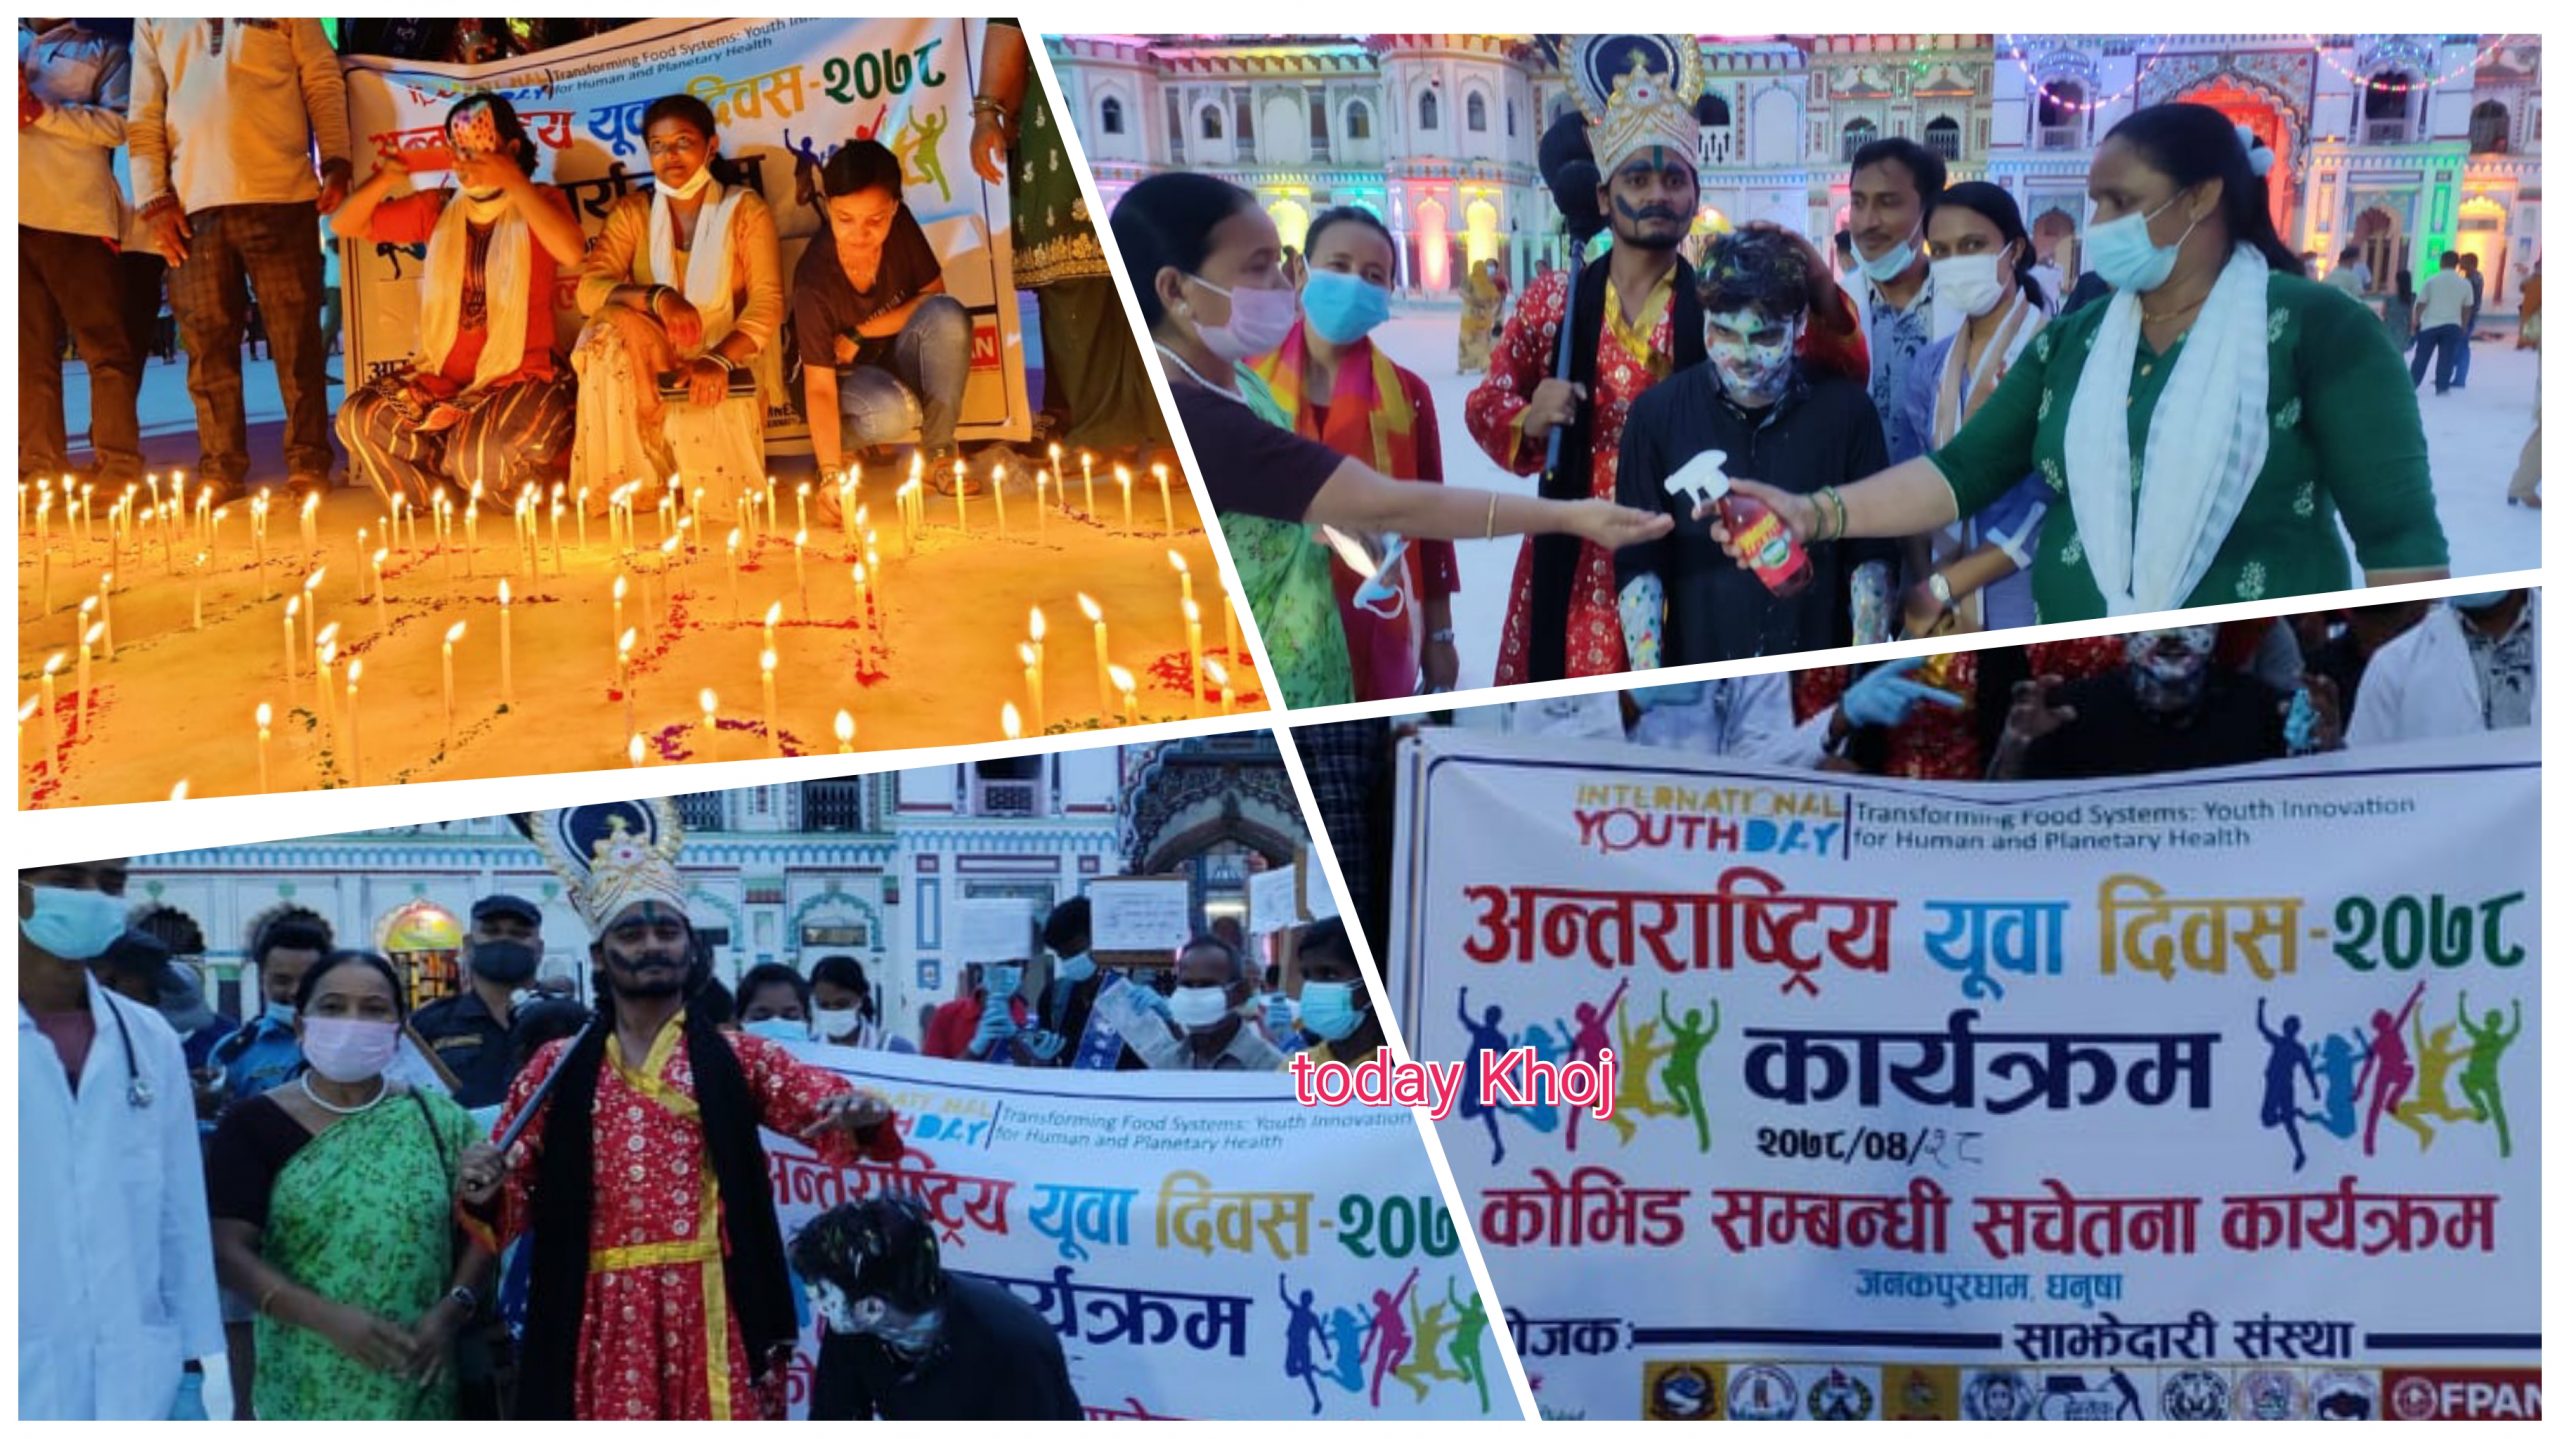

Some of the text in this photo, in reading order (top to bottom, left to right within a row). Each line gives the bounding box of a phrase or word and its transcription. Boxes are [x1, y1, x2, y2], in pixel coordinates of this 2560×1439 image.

[554, 55, 640, 82] Transforming
[643, 45, 677, 63] Food
[680, 32, 740, 56] Systems:
[745, 20, 786, 38] Youth
[555, 37, 773, 96] for Human and Planetary Health
[1853, 826, 2251, 852] for Human and Planetary Health
[1857, 796, 2415, 830] Transforming Food Systems: Youth Innovation
[1923, 900, 2069, 1001] यूवा
[1743, 1008, 2222, 1116] कार्यक्रम
[1001, 1106, 1117, 1132] Transforming
[1122, 1114, 1167, 1132] Food
[1256, 1114, 1306, 1132] Youth
[1311, 1111, 1412, 1129] Innovation
[1026, 1129, 1090, 1147] Human
[1094, 1131, 1130, 1149] and
[1133, 1134, 1219, 1152] Planetary
[1224, 1133, 1284, 1151] Health
[1028, 1183, 1139, 1261] यूवा
[1480, 1166, 1691, 1249] कोभिड
[1971, 1178, 2202, 1260] सचेतना
[2221, 1175, 2501, 1257] कार्यक्रम
[2233, 1311, 2355, 1360] संस्था
